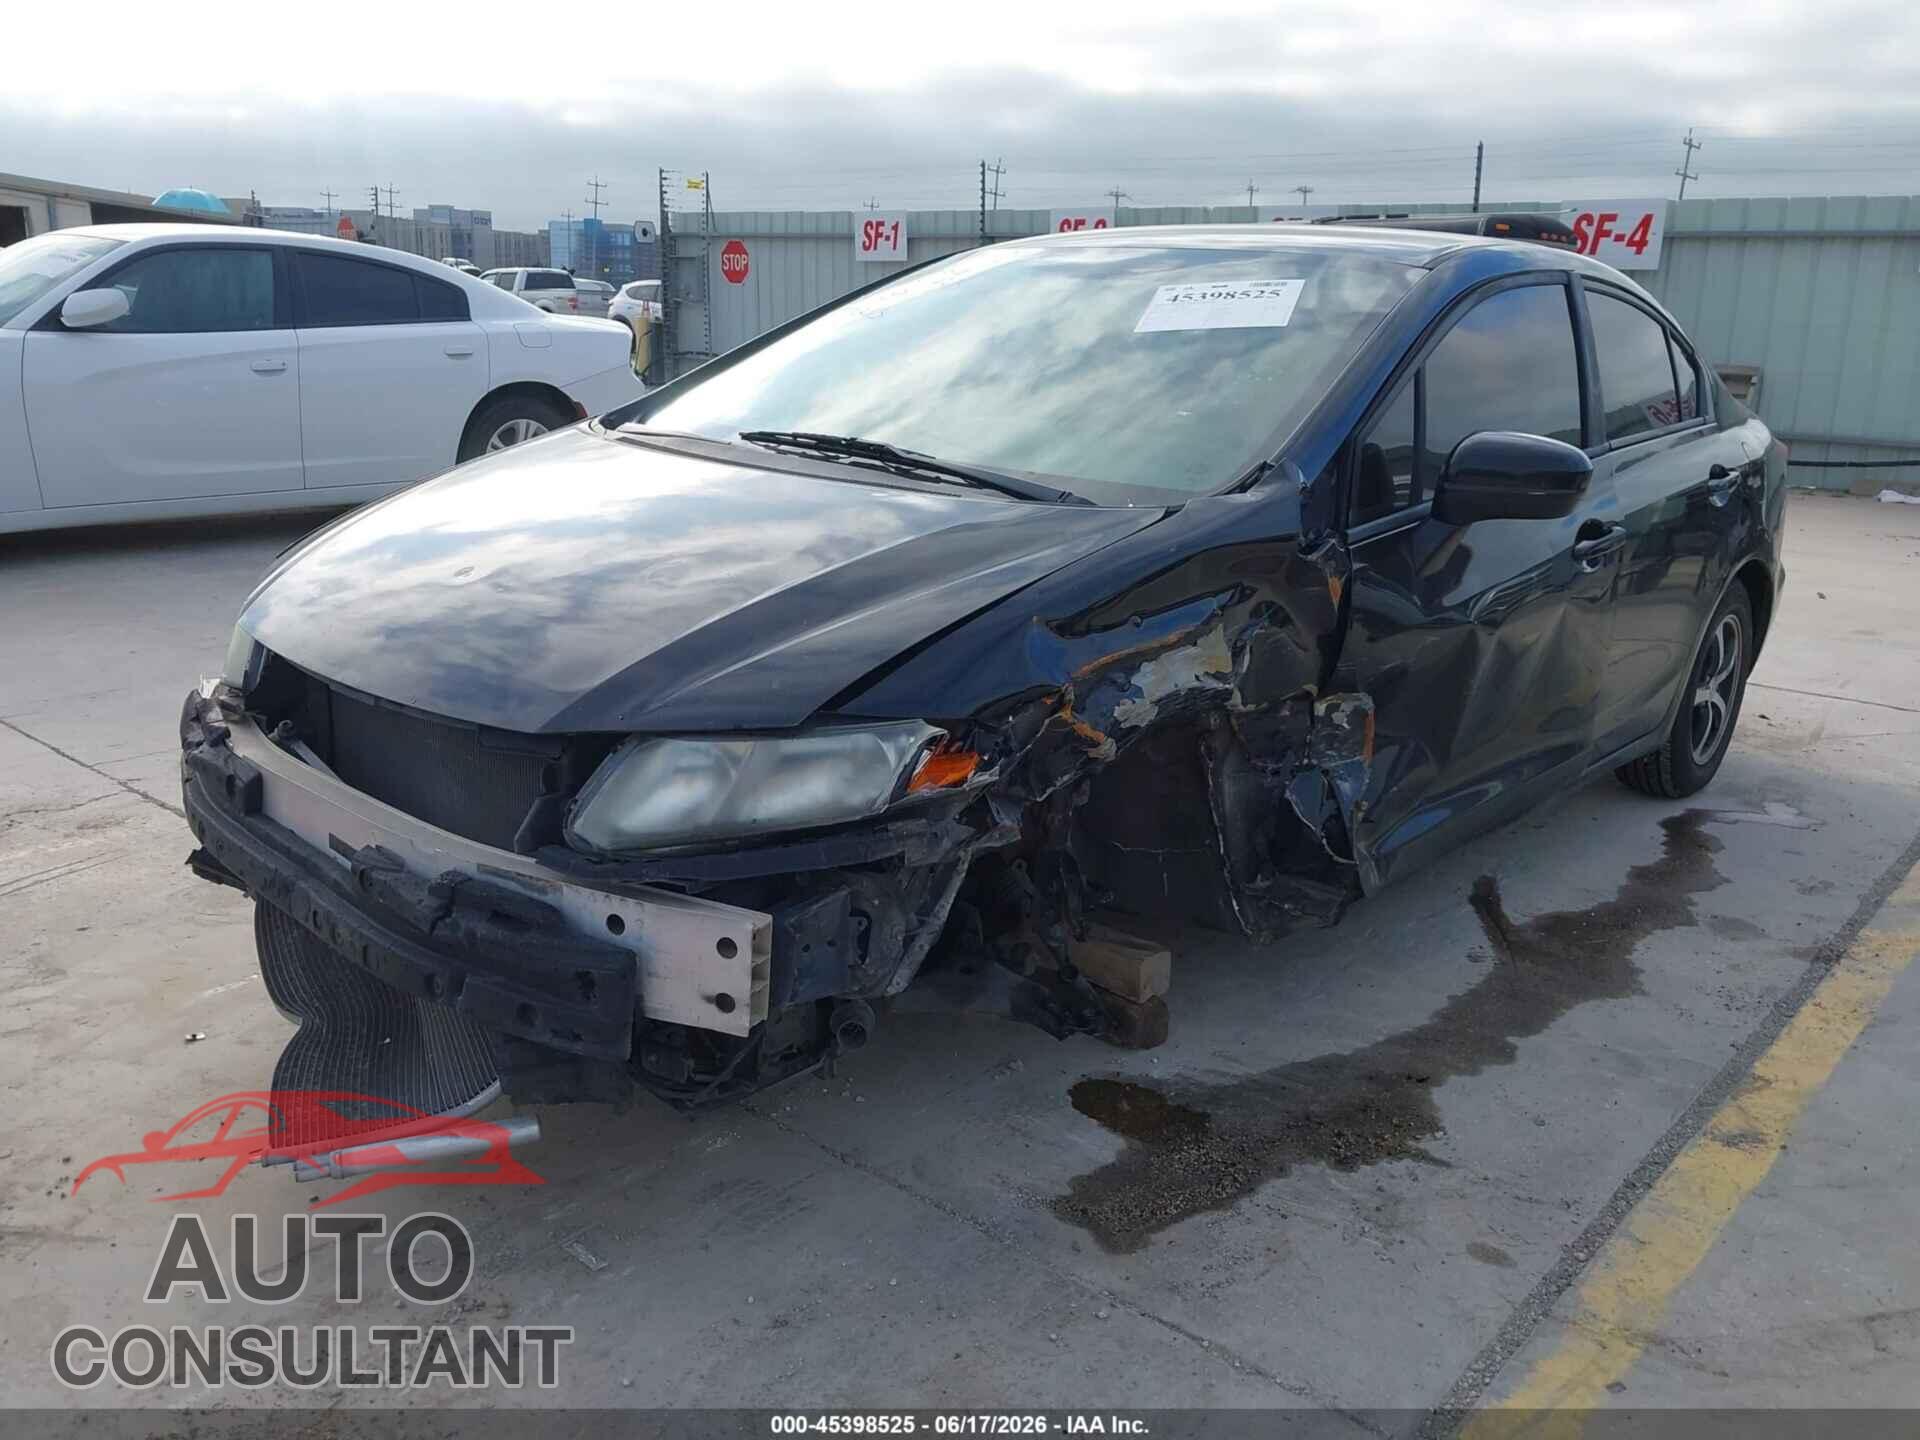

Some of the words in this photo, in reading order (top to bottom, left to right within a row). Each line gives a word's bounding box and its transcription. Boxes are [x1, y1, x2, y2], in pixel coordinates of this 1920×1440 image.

[862, 220, 900, 252] SF-1
[1572, 212, 1655, 256] SF-4
[723, 254, 748, 271] STOP
[1164, 288, 1282, 303] 45398525
